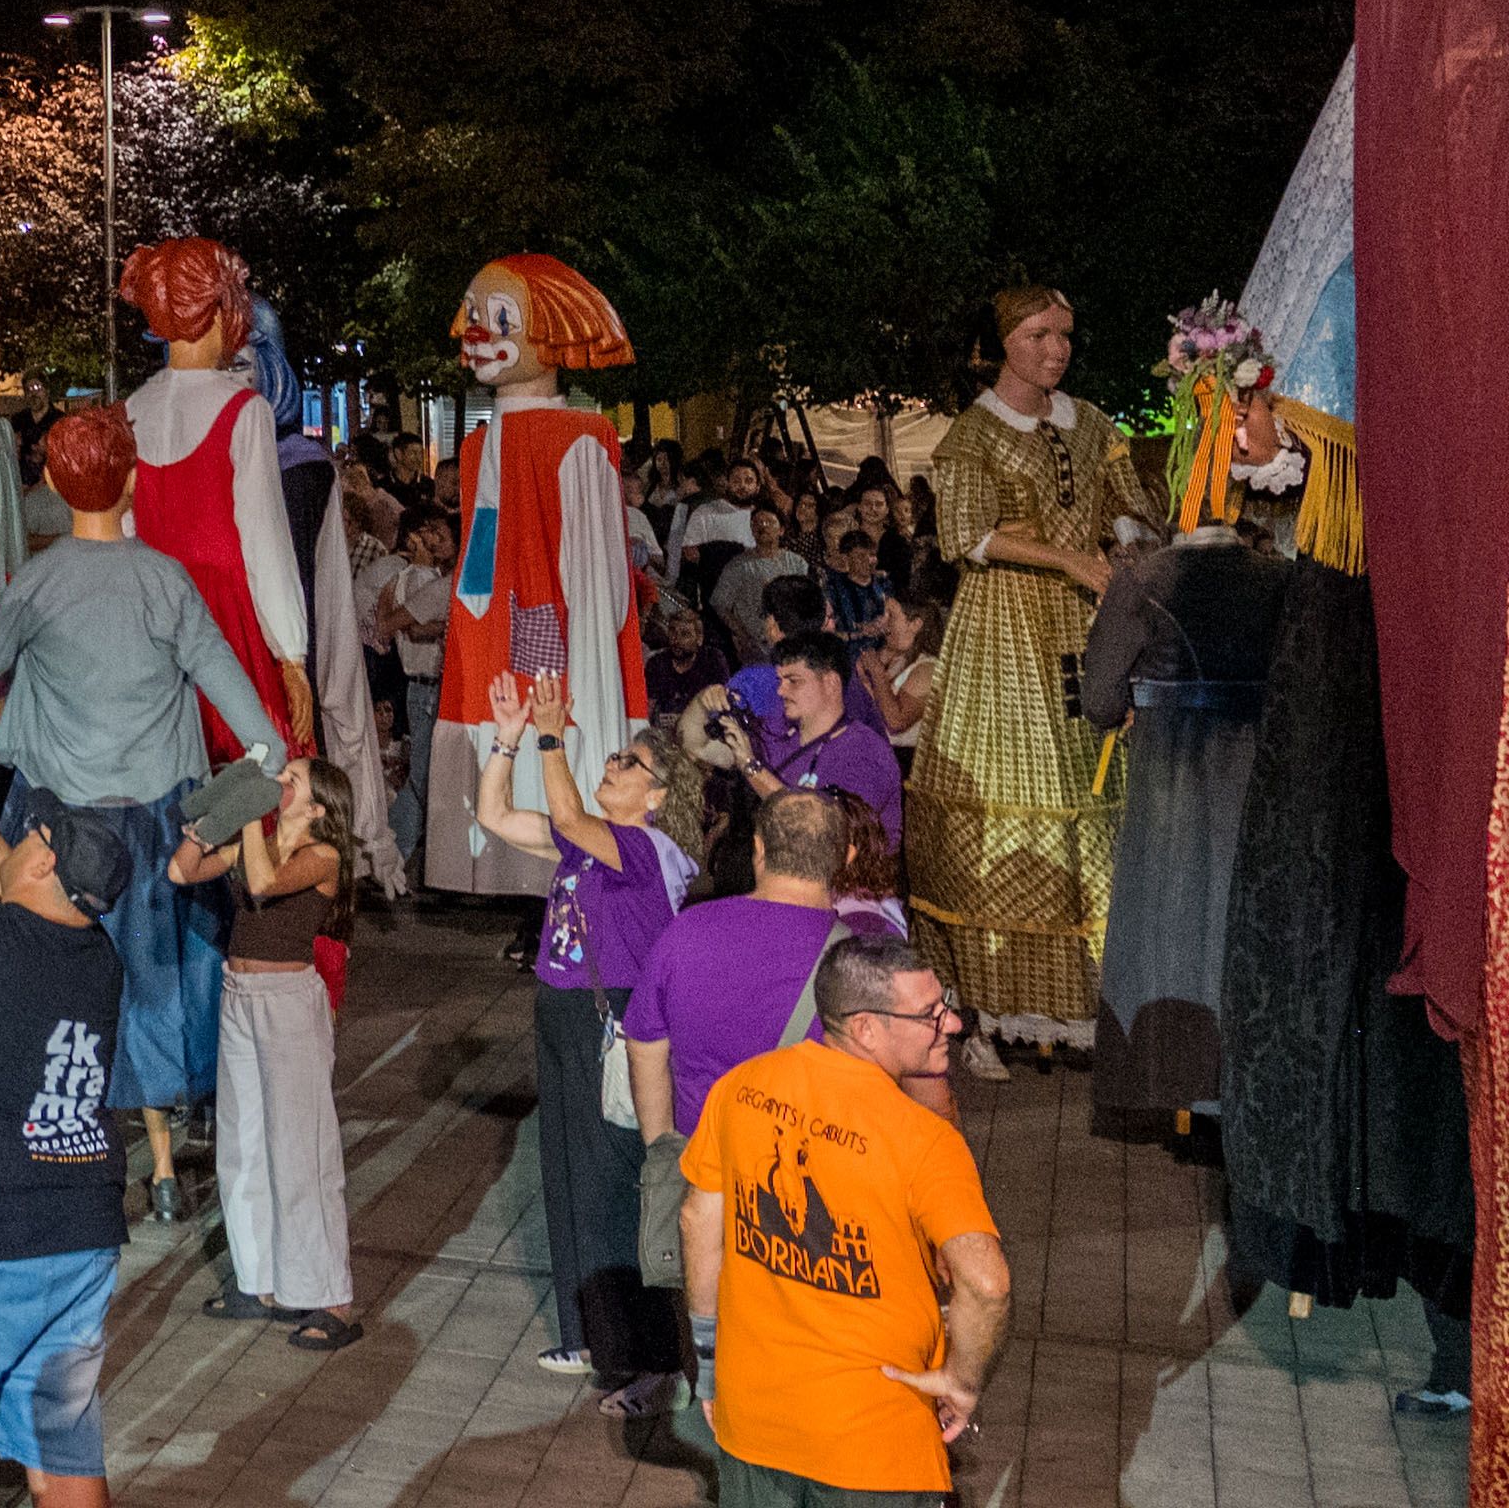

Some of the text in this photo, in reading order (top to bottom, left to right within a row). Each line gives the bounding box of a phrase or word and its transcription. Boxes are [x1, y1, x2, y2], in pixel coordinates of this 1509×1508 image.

[737, 1086, 869, 1156] GEGANTS I CABUTS
[736, 1217, 878, 1296] BORRIANA
